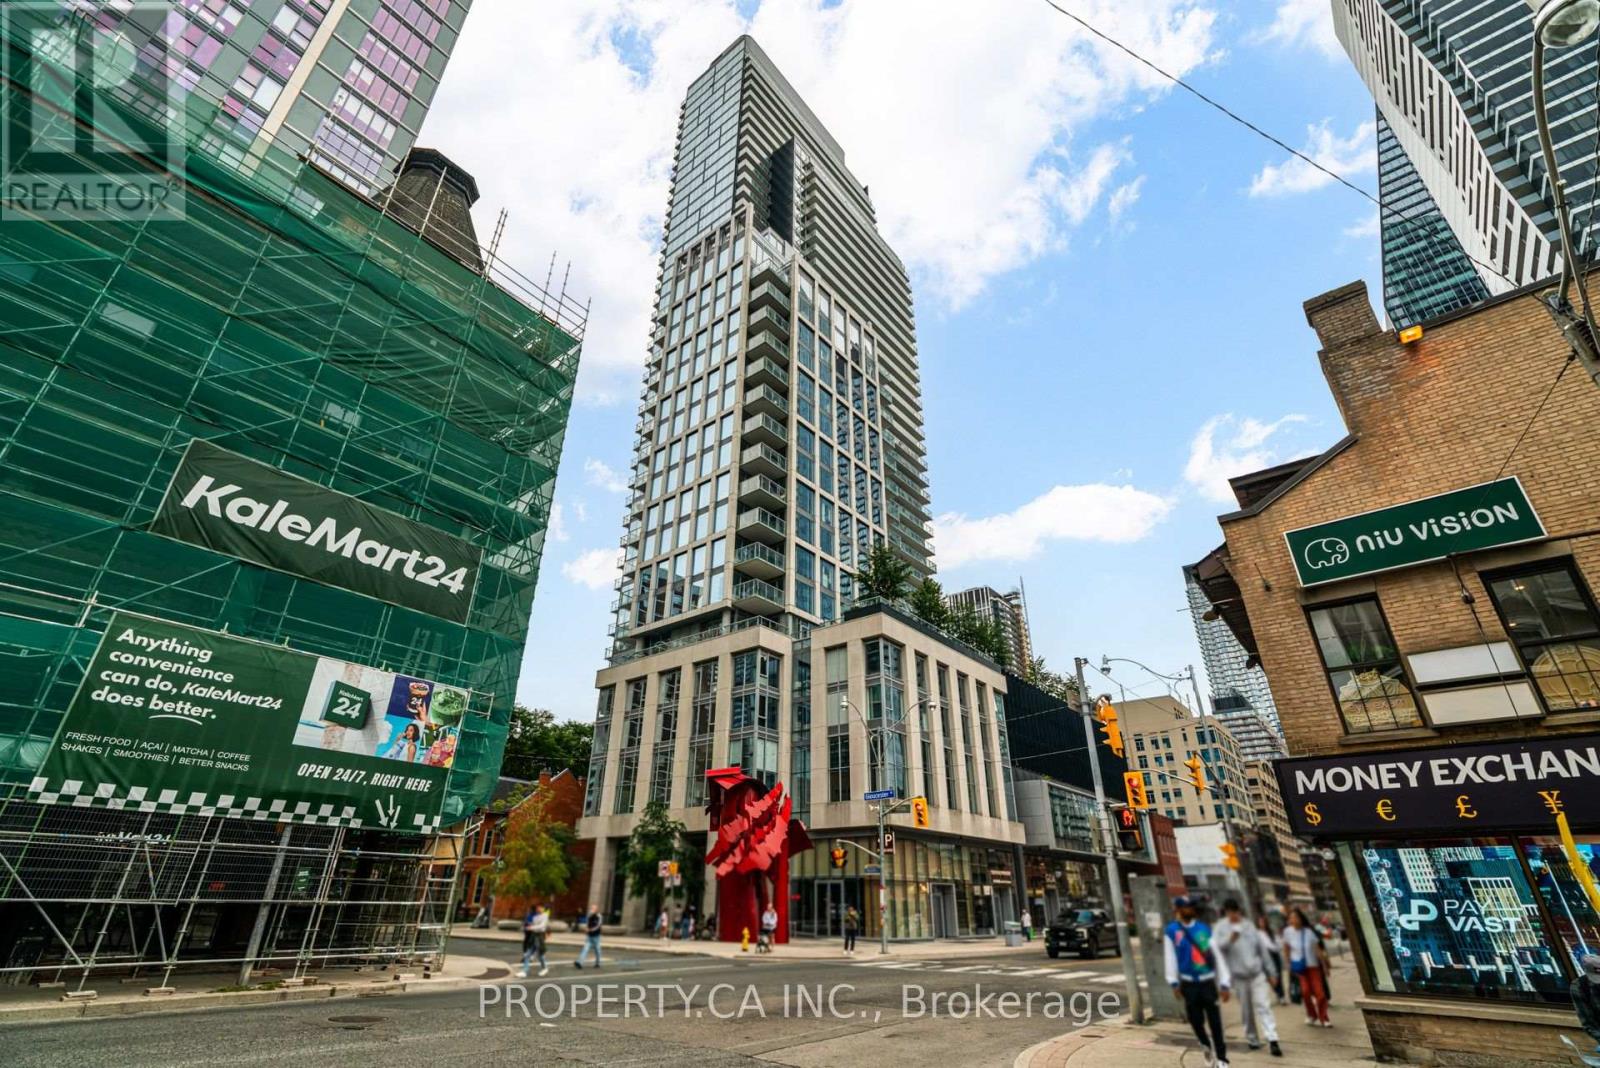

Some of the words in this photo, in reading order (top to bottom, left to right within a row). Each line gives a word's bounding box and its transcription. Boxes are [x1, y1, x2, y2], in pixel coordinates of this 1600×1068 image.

[180, 474, 469, 595] KaleMart24
[117, 628, 213, 663] Anything
[109, 650, 235, 683] convenience
[91, 686, 144, 707] does
[149, 694, 217, 719] better.
[100, 670, 140, 686] can
[144, 674, 178, 695] do,
[181, 682, 283, 710] KaleMart24
[332, 697, 362, 719] 24
[60, 742, 103, 755] SHAKES
[112, 749, 170, 762] SMOOTHIES
[178, 757, 214, 768] BETTER
[214, 761, 250, 772] SNACKS
[65, 731, 101, 743] FRESH
[102, 736, 132, 747] FOOD
[172, 745, 209, 756] MATCHA
[217, 751, 251, 762] COFFEE
[297, 763, 333, 779] OPEN
[332, 767, 367, 786] 24/7,
[370, 773, 405, 788] RIGHT
[404, 777, 433, 792] HERE
[1295, 760, 1423, 795] MONEY
[1429, 747, 1600, 786] EXCHAN
[1304, 802, 1322, 826] $
[1376, 799, 1396, 821] €
[1455, 795, 1478, 819] £
[884, 833, 893, 847] P
[1443, 899, 1490, 915] PAY
[1445, 915, 1522, 933] VAST
